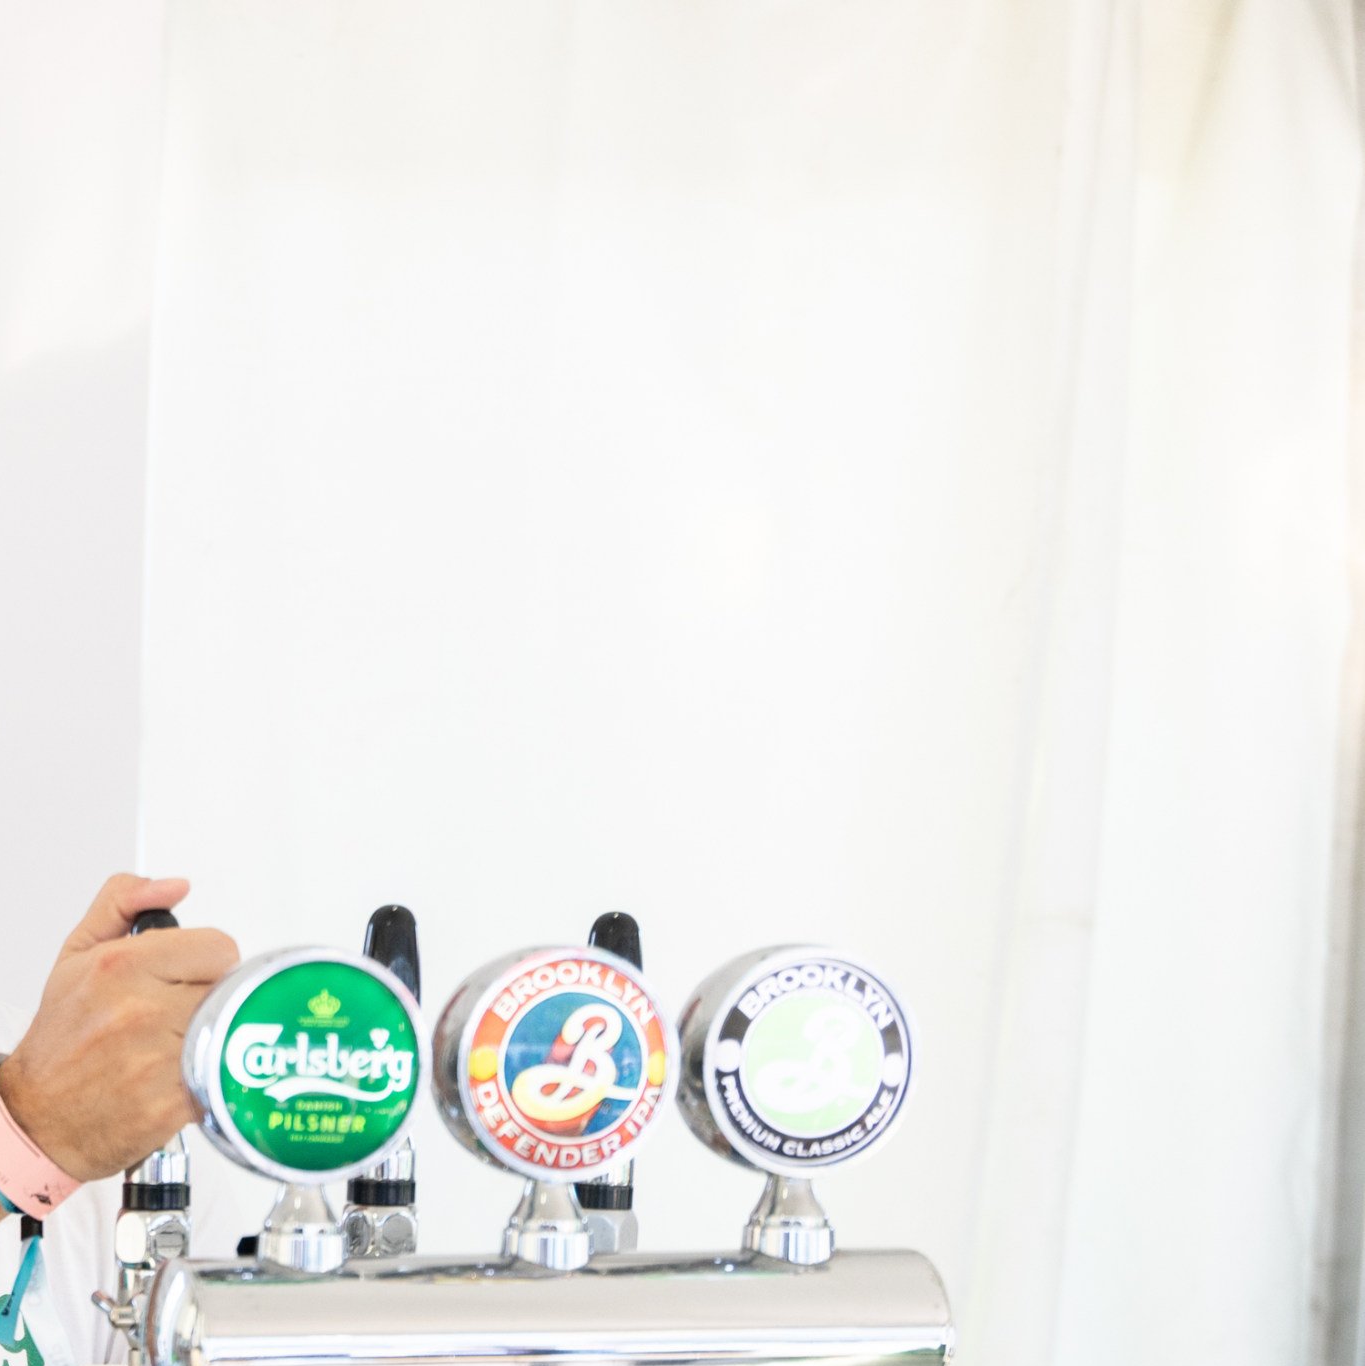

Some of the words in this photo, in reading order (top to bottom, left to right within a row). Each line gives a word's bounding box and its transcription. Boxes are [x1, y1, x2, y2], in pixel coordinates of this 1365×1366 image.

[492, 961, 655, 1028] BROOKLYN
[737, 965, 894, 1030] BROOKLYN
[226, 1023, 414, 1094] Carlsberg
[268, 1112, 366, 1133] PILSNER
[476, 1081, 621, 1167] DEFENDER
[626, 1087, 661, 1135] IPA
[720, 1075, 782, 1151] PREMIUM
[782, 1124, 866, 1158] CLASSIC
[864, 1090, 895, 1131] ALE
